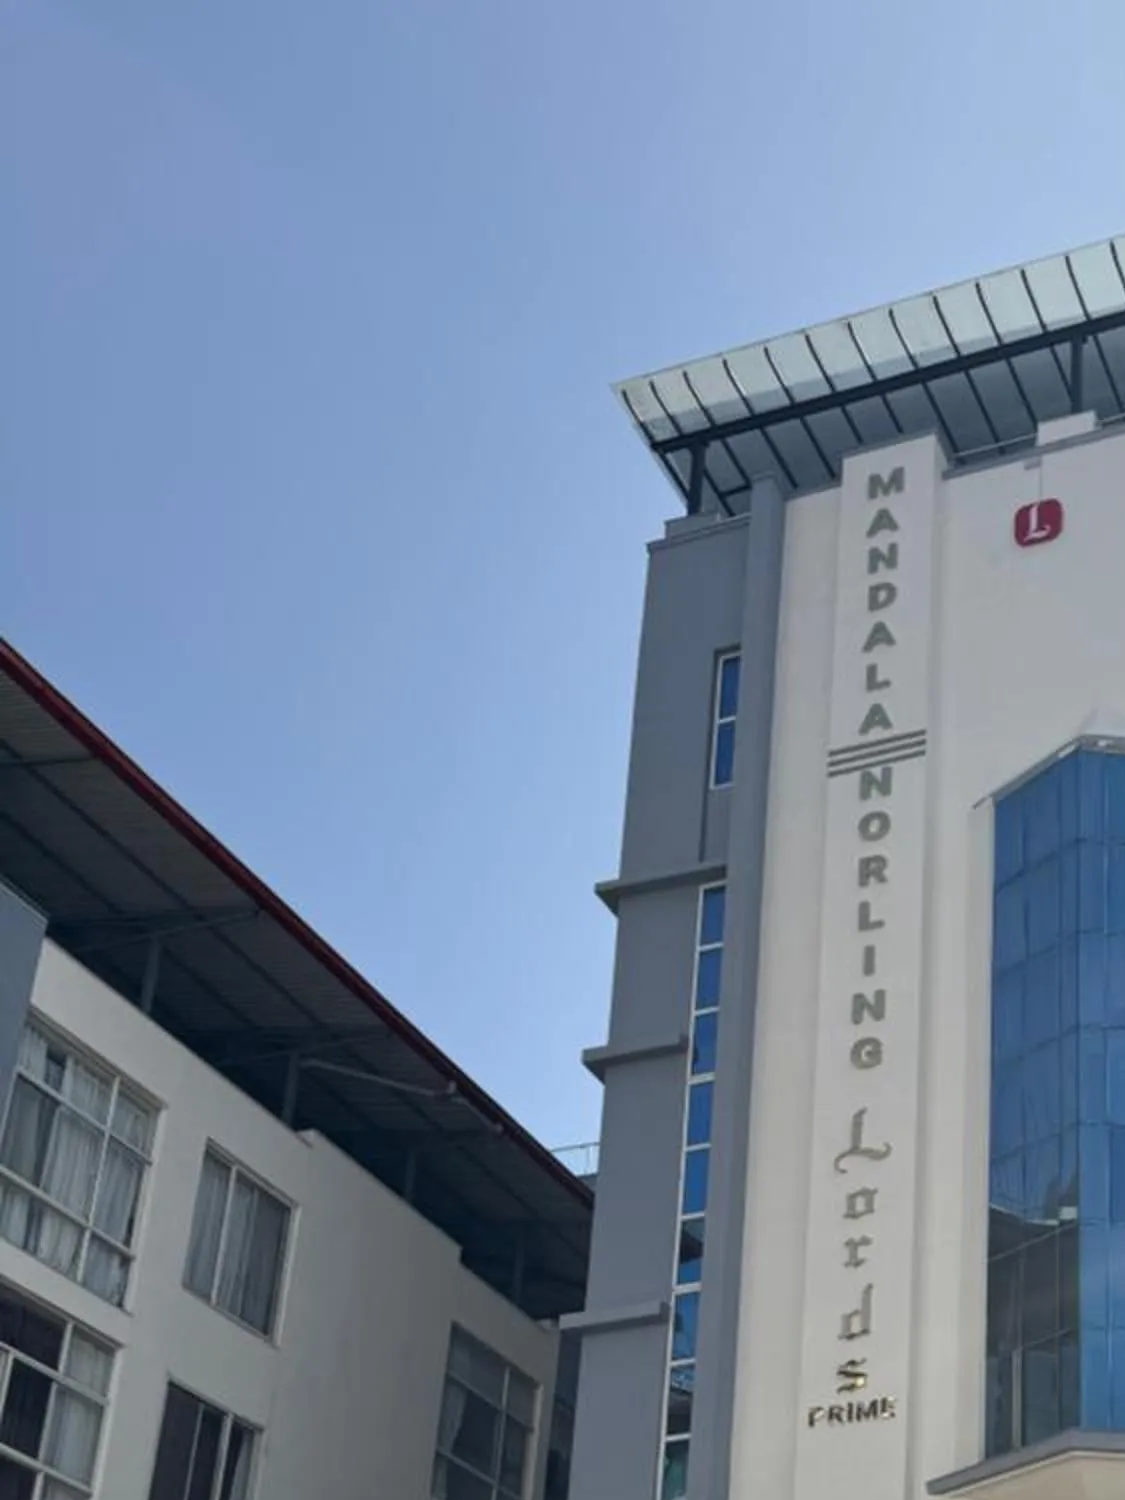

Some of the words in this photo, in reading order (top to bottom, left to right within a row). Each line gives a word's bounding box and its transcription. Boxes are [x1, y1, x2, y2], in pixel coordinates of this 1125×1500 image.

[859, 467, 905, 736] MANDALA
[1023, 504, 1051, 542] L
[850, 767, 893, 1070] NORLING
[834, 1108, 892, 1394] Lords
[808, 1397, 897, 1427] PRIME
